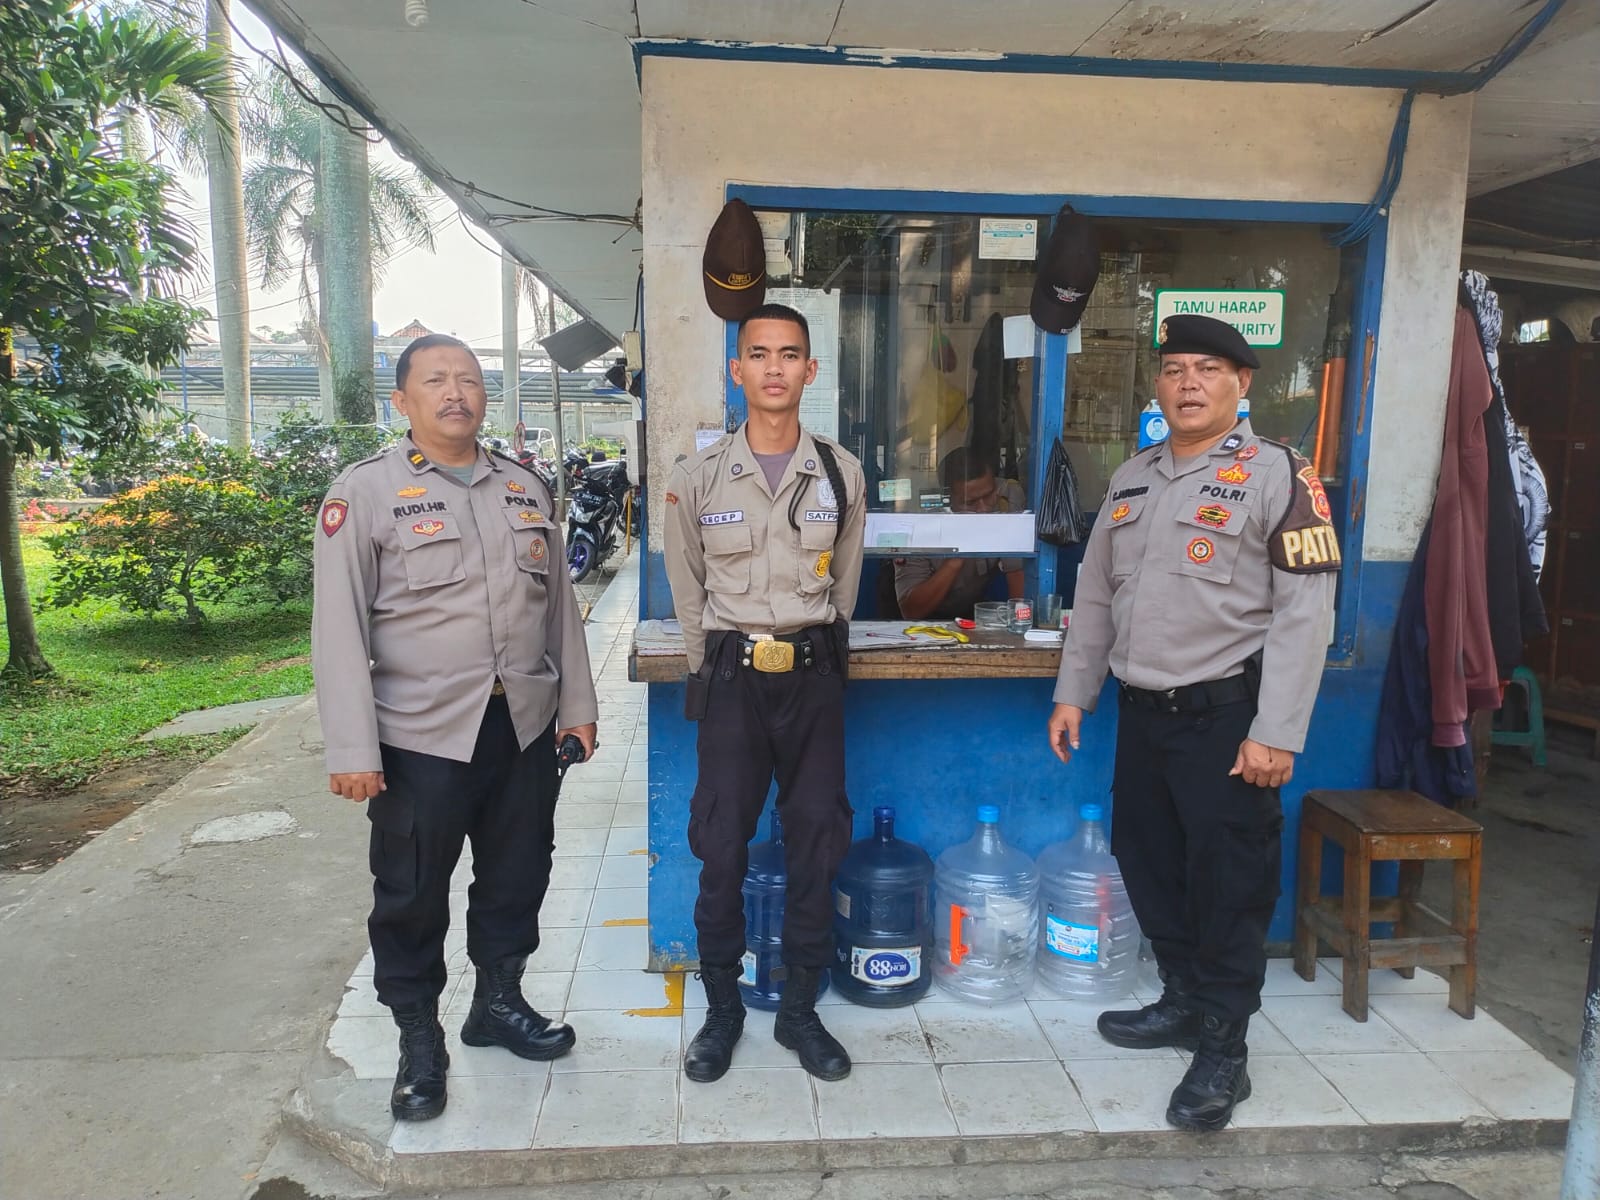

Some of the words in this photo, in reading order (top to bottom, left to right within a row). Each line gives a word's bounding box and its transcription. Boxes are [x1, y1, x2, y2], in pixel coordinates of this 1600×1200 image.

[1173, 301, 1214, 313] TAMU
[1219, 301, 1266, 313] HARAP
[1199, 485, 1246, 502] POLRI
[505, 496, 539, 508] POLRI
[393, 502, 447, 519] RUDI.HR
[807, 512, 838, 520] SATPA
[1282, 526, 1341, 568] PATR
